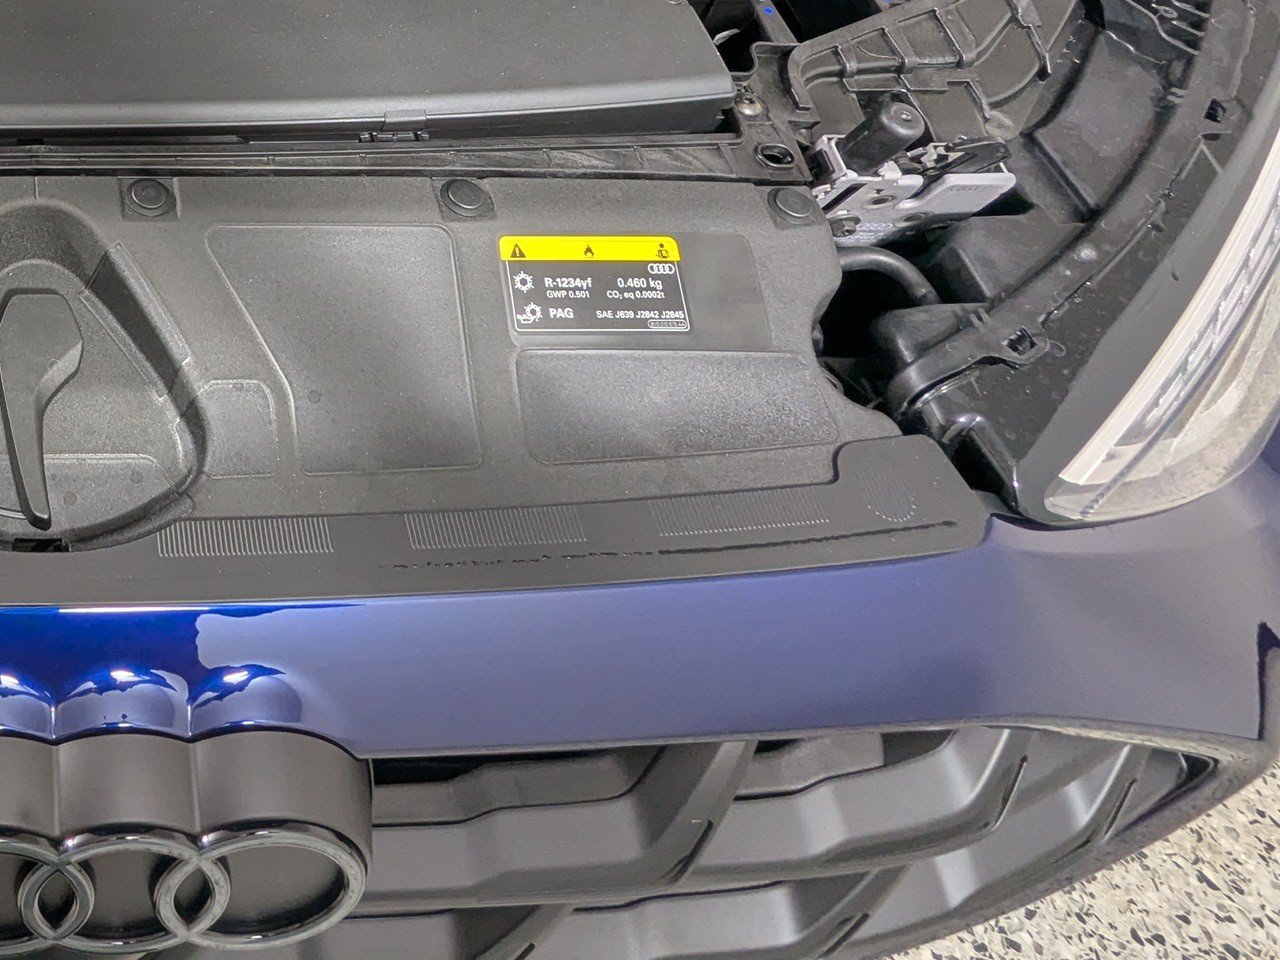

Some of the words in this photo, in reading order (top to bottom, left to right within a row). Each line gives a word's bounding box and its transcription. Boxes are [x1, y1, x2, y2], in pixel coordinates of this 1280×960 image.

[544, 277, 592, 289] R-1234yf
[617, 278, 647, 288] 0.460
[648, 278, 663, 290] kg
[546, 290, 567, 298] GWP
[568, 290, 590, 298] 0.501
[623, 292, 634, 300] eq
[635, 290, 665, 299] 0.0002t
[548, 308, 574, 319] PAG
[596, 310, 614, 319] SAE
[615, 310, 634, 318] J639
[636, 310, 659, 318] J2842
[661, 310, 684, 318] J2845
